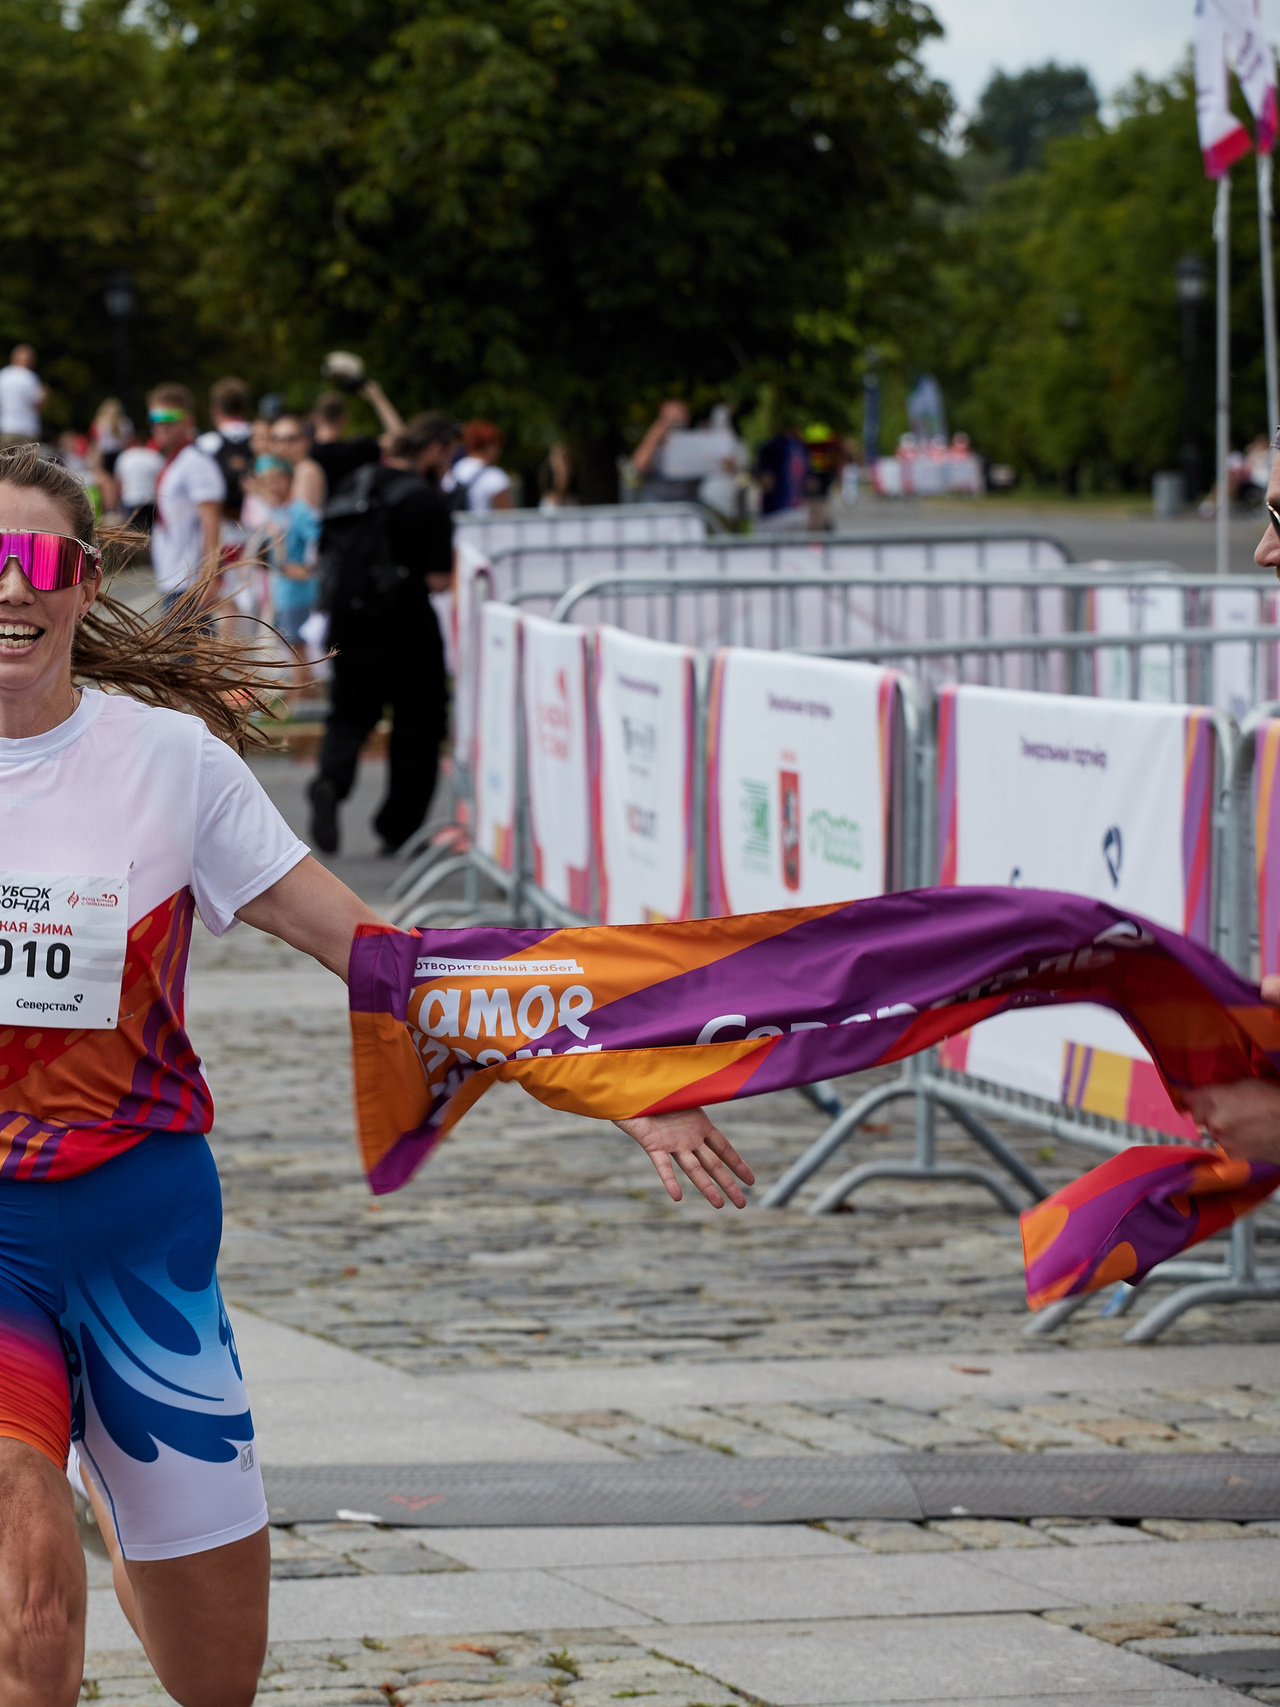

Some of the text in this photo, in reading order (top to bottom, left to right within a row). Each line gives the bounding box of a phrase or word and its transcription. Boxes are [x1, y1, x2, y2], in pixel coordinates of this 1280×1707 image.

[32, 923, 73, 937] ЗИМА
[532, 963, 575, 973] забег
[16, 998, 79, 1012] Северсталь
